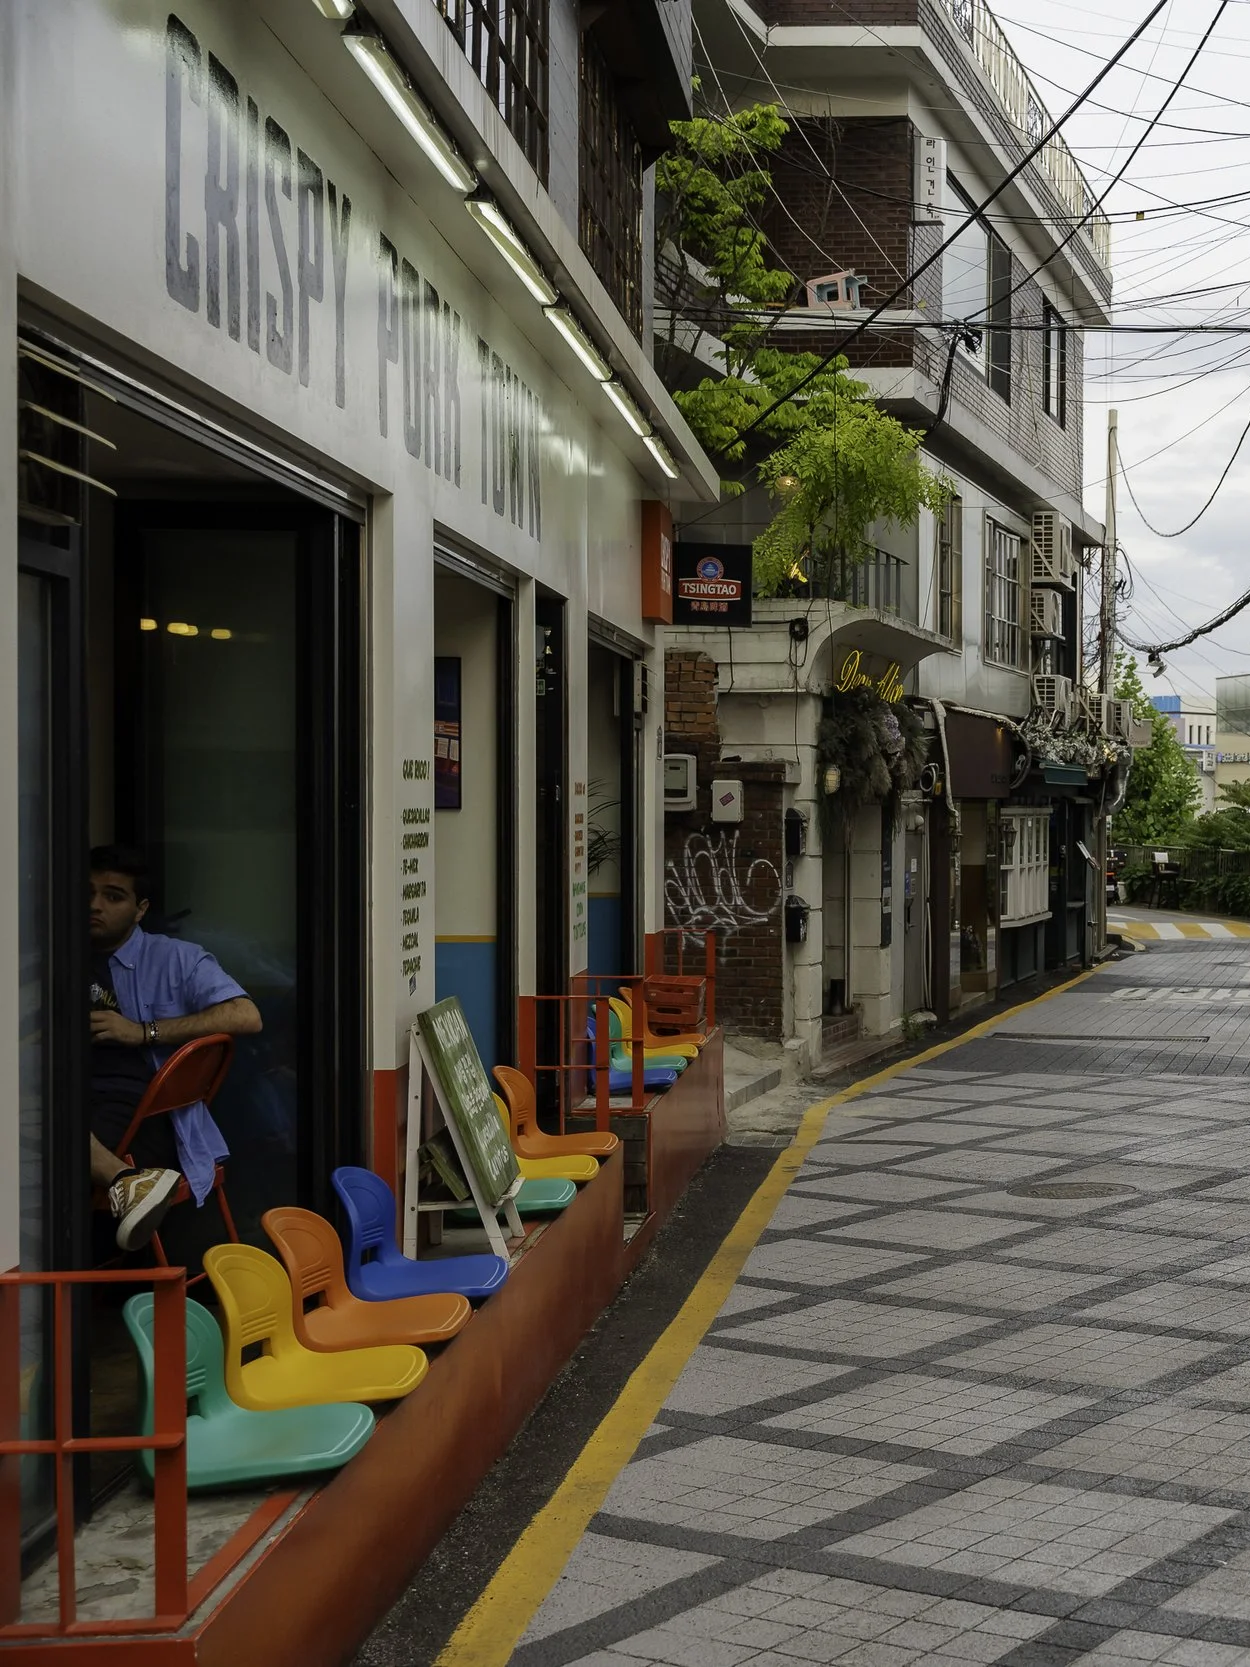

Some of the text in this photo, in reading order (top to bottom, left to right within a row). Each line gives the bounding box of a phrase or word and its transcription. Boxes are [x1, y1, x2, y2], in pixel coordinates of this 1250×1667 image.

[165, 13, 541, 543] CRISPY PORK TOWN
[682, 583, 737, 595] TSINGTAO
[432, 1008, 469, 1052] MEXICAN
